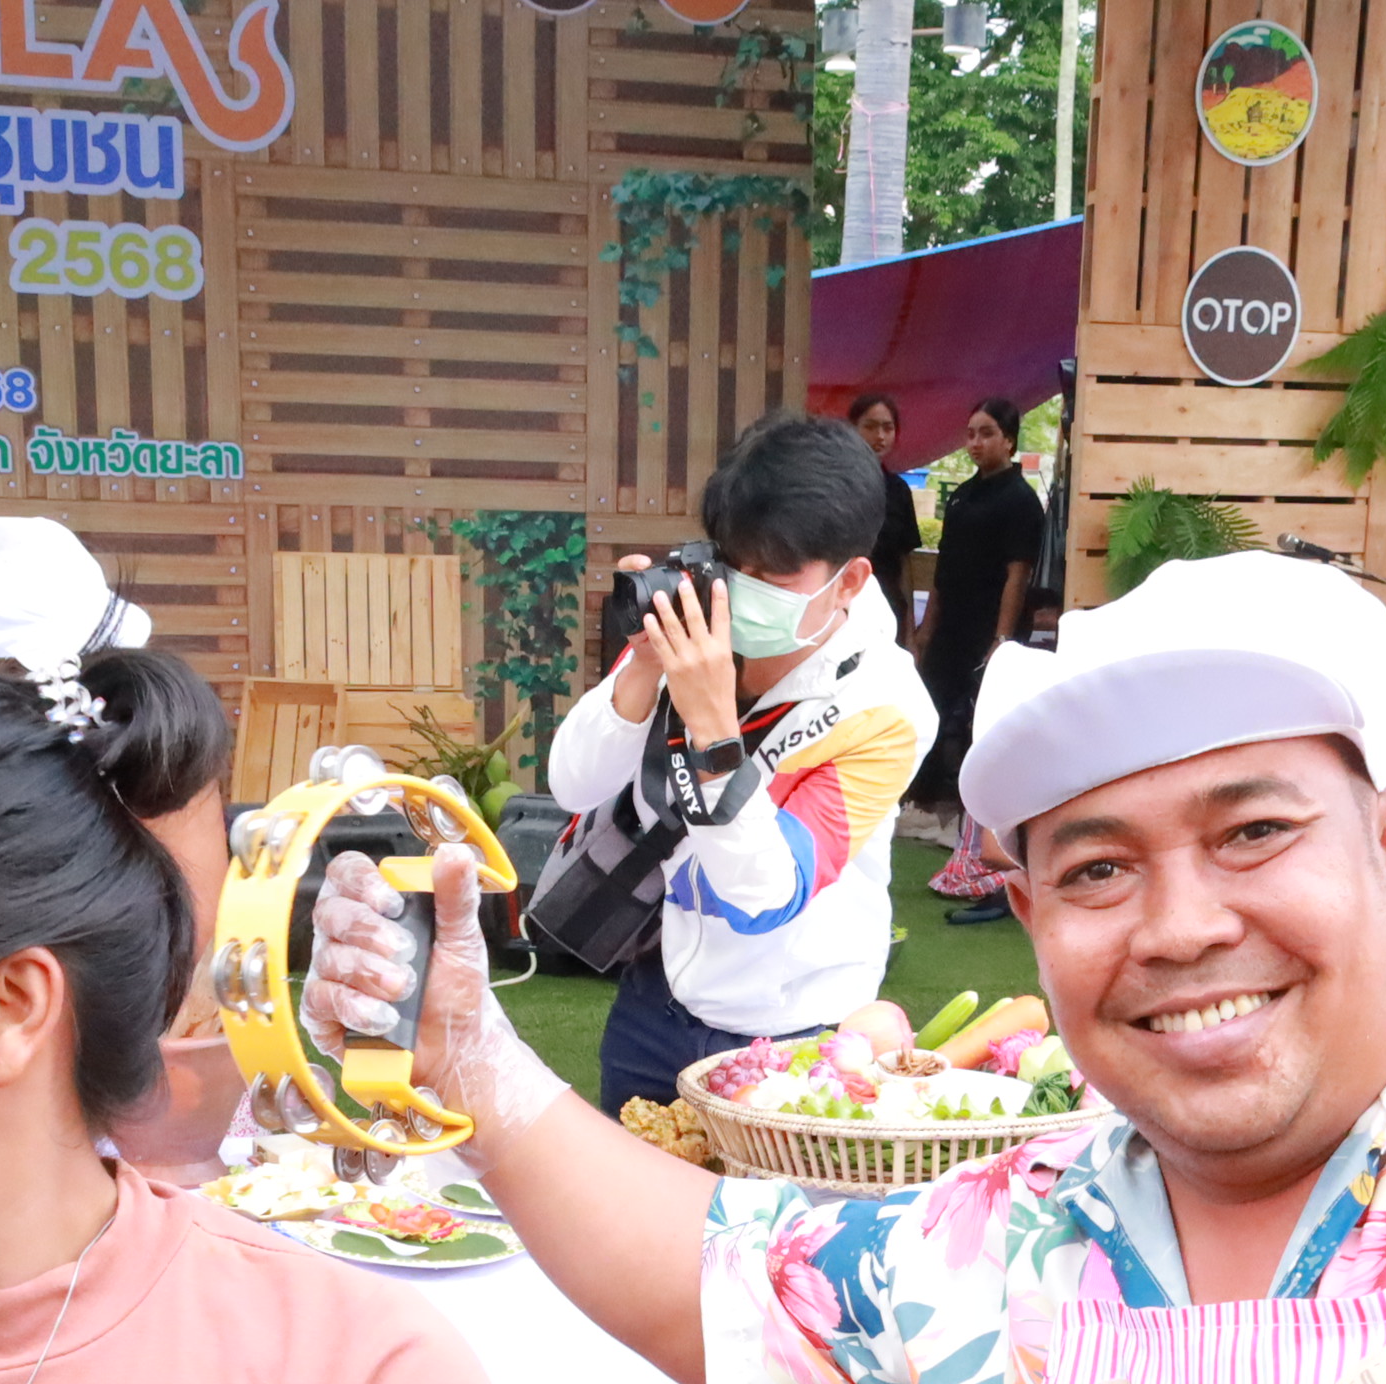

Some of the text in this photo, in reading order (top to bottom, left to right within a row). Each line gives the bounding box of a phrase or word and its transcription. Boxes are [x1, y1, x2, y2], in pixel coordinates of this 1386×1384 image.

[17, 226, 198, 292] 2568
[1192, 297, 1292, 335] OTOP
[30, 427, 242, 477] จังหวัดยะลา
[671, 753, 702, 815] SONY
